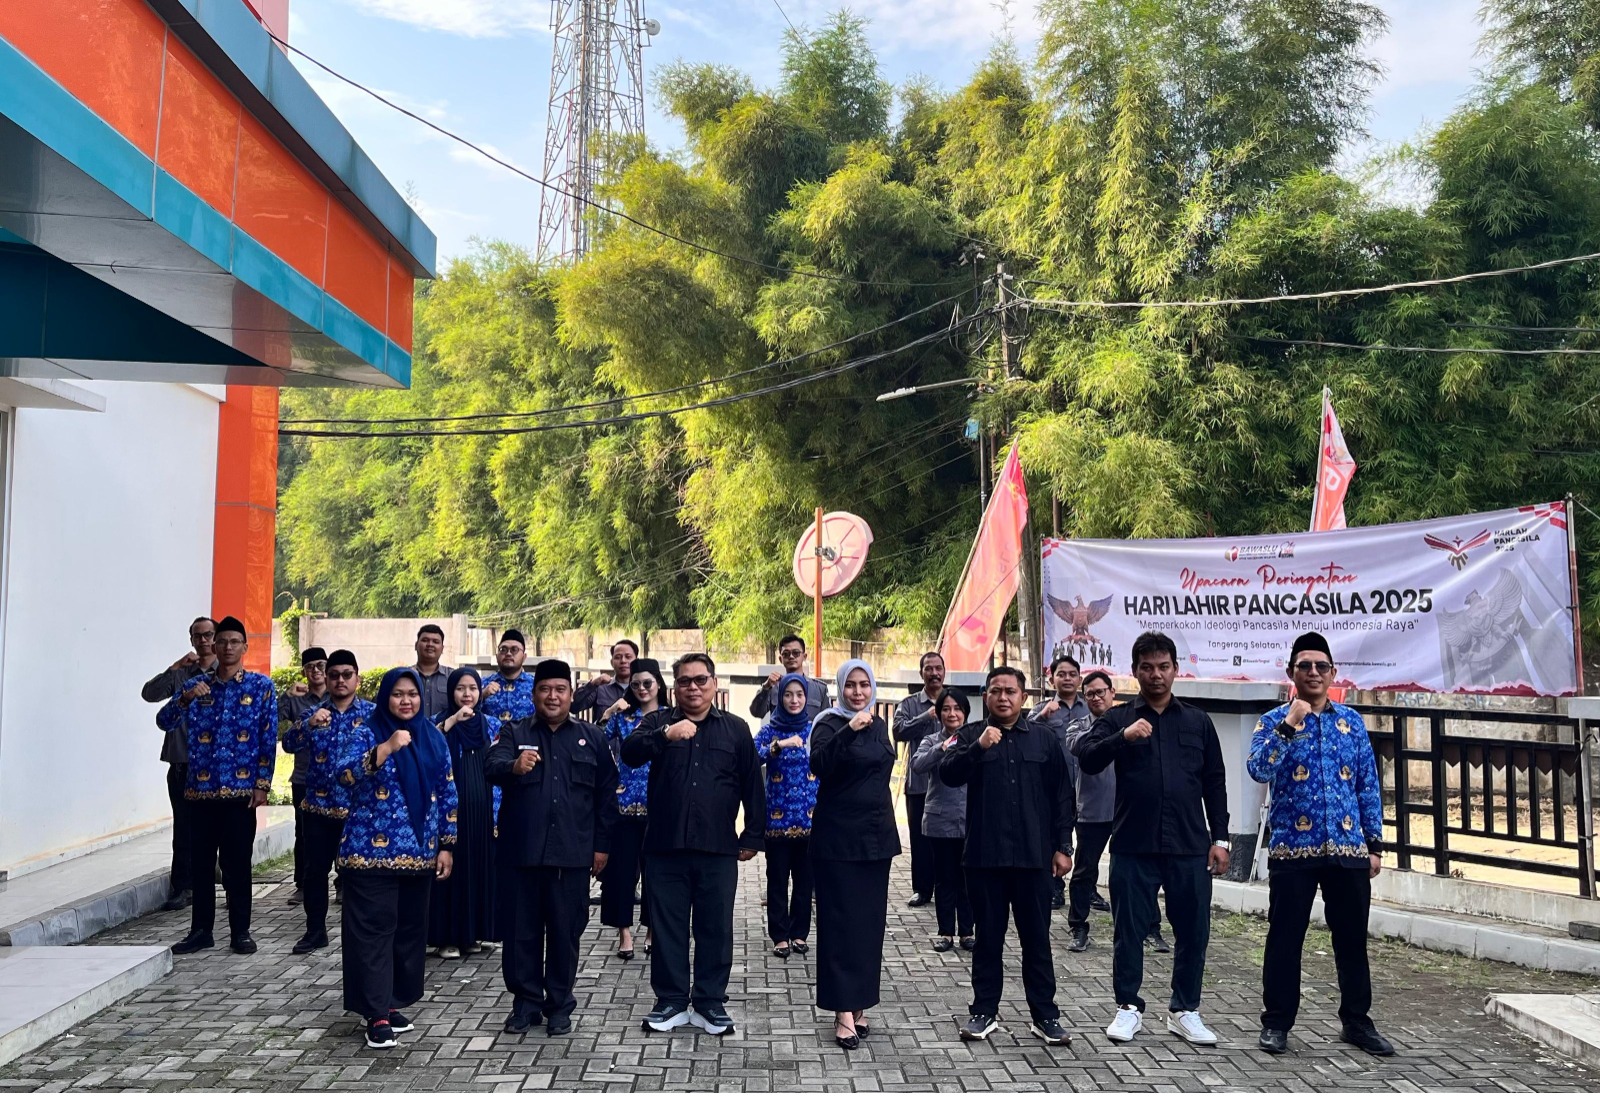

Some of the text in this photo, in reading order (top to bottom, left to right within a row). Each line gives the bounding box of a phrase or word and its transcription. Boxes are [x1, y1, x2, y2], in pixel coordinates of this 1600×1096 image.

[1494, 534, 1540, 544] PANCSILA
[1240, 545, 1278, 553] BAWASLU
[1179, 561, 1358, 596] Upacara Peringatan
[1124, 589, 1433, 615] HARI LAHIR PANCASILA 2025
[1204, 620, 1241, 632] Ideologi
[1243, 620, 1289, 631] Pancasila
[1292, 620, 1329, 632] Menuju
[1332, 619, 1382, 631] Indonesia
[1208, 641, 1248, 650] Tangerang
